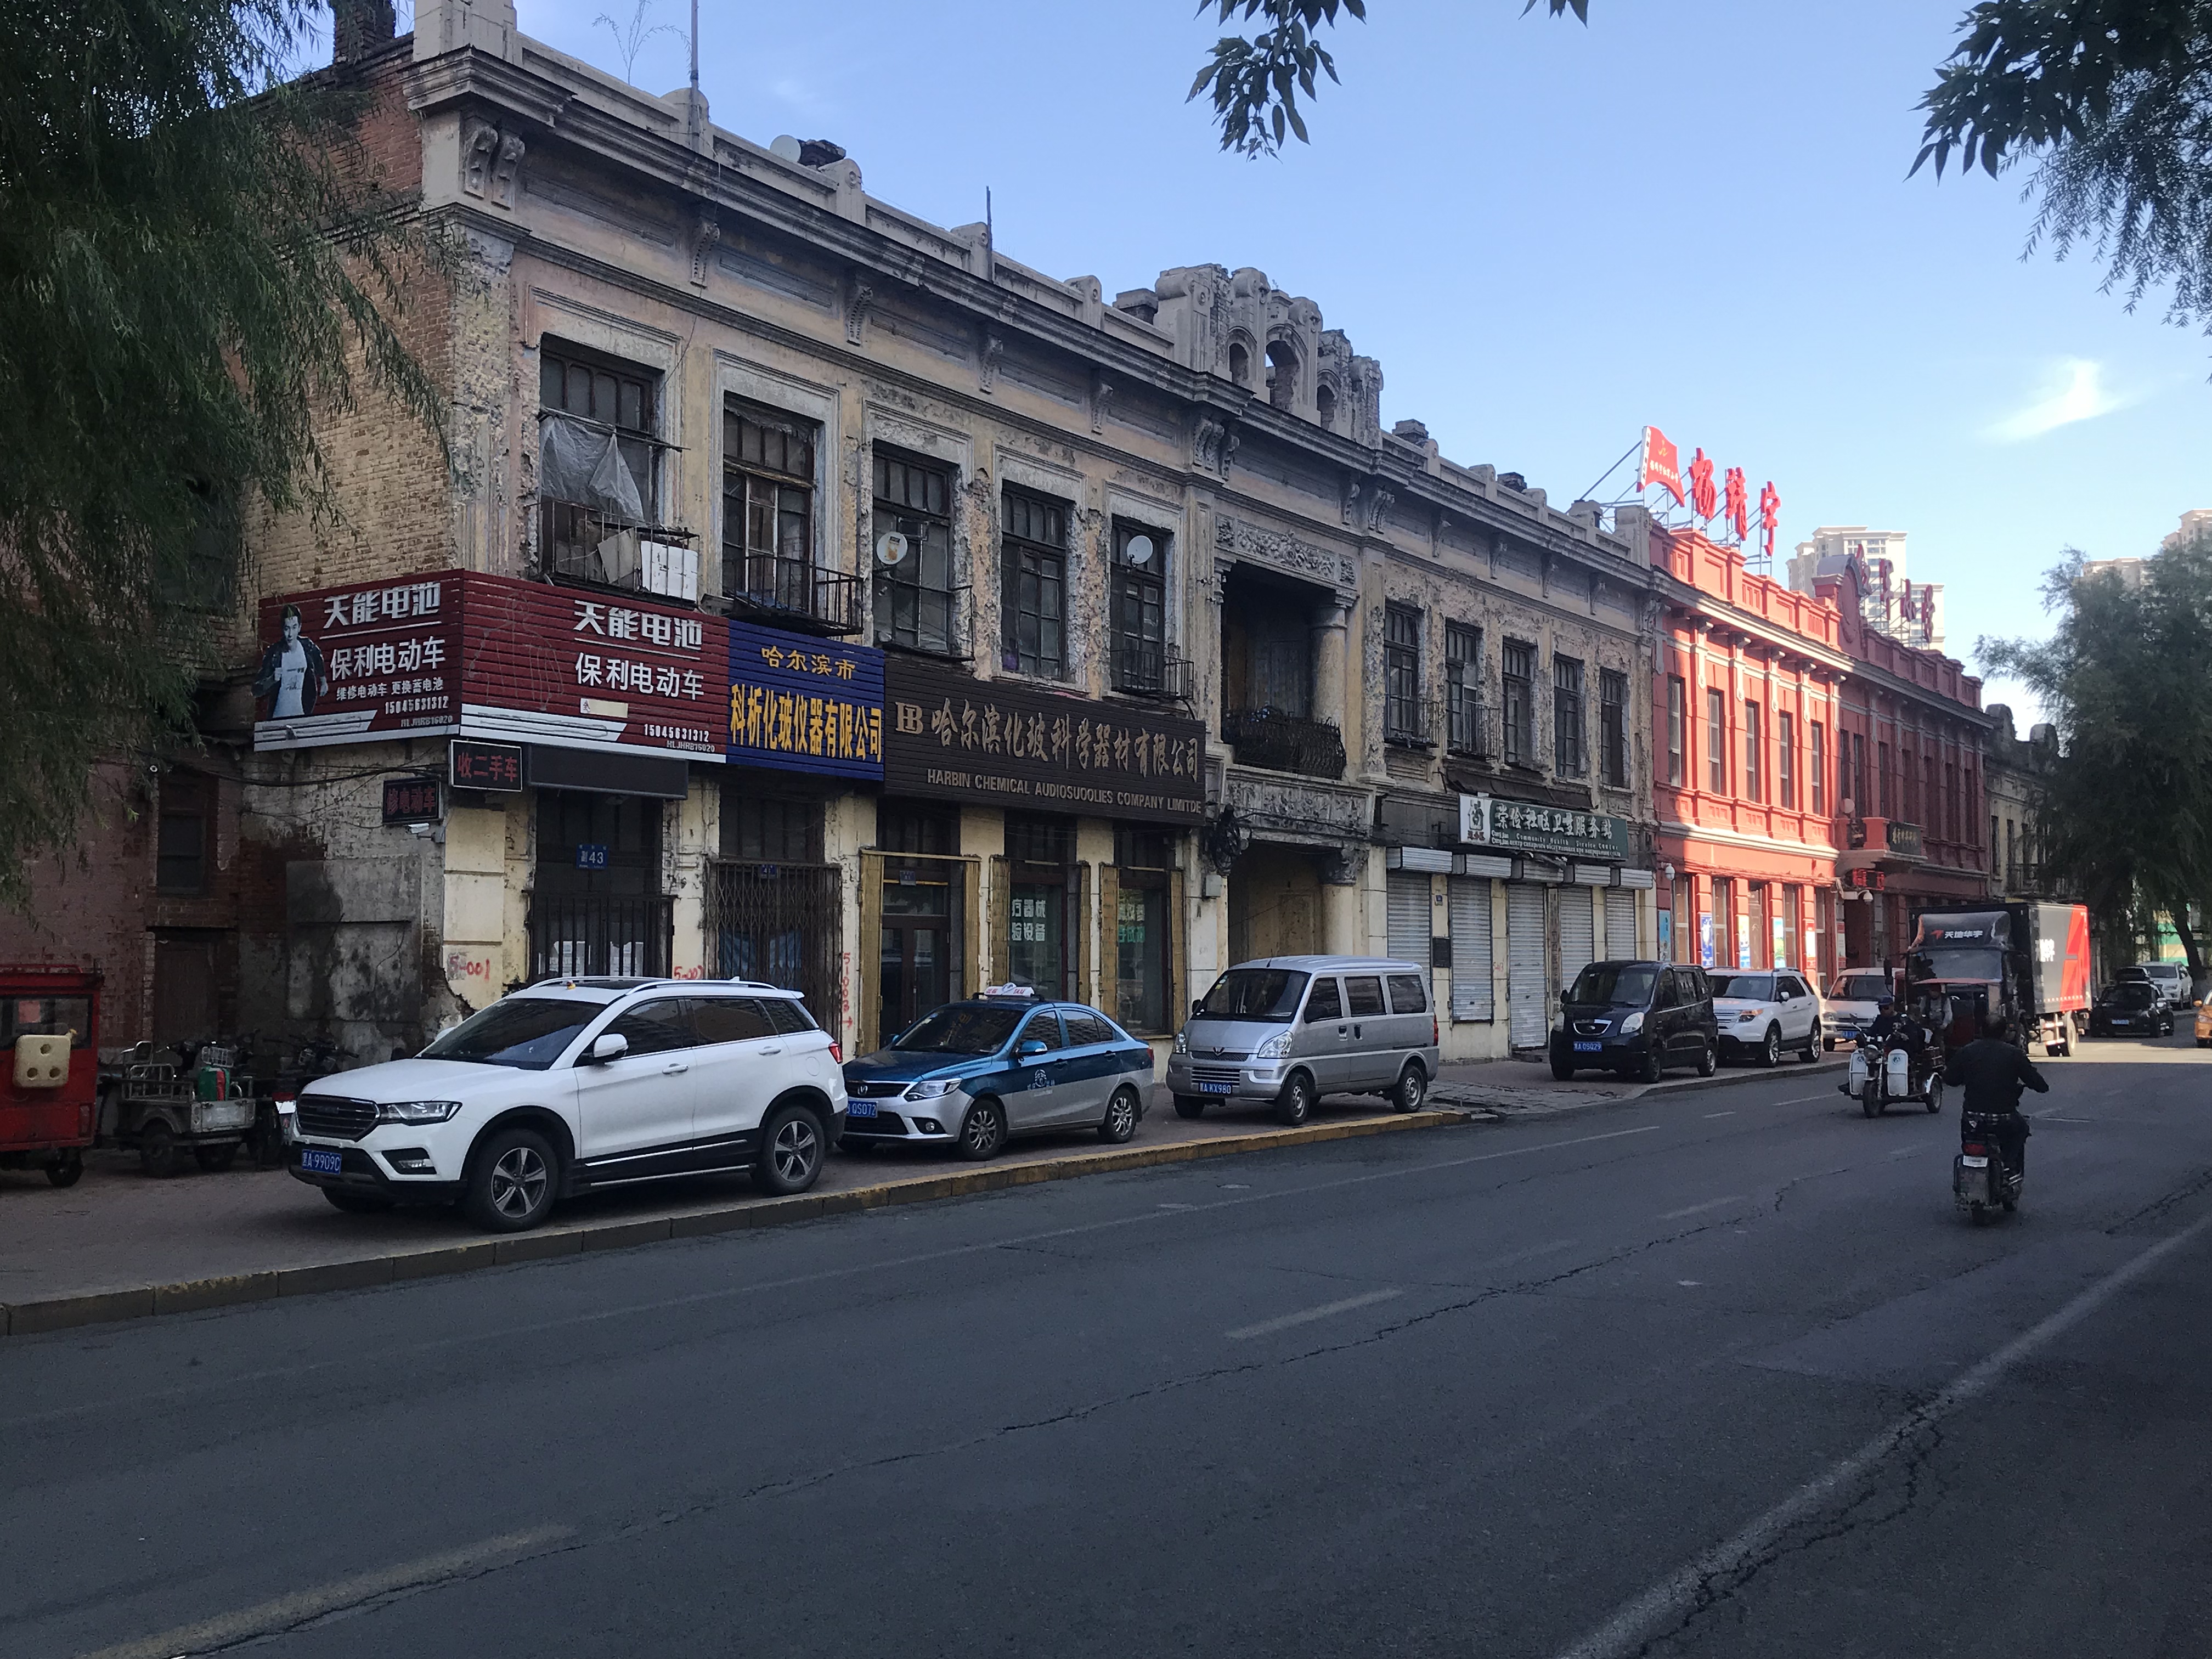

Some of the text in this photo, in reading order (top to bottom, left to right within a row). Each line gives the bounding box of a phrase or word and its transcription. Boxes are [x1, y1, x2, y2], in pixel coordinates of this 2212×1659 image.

[323, 582, 441, 629] 天能电池
[573, 600, 702, 650] 天能电池
[330, 636, 446, 681] 保利电动车
[575, 652, 704, 700] 保利电动车
[761, 645, 856, 680] 哈尔滨市
[336, 676, 444, 701] 维修电动车 更换蓄电池
[385, 696, 449, 714] 15045631312
[644, 724, 709, 742] 15045631312
[731, 684, 882, 763] 科析化玻仪器有限公司
[931, 698, 1197, 783] 哈尔滨化玻科学器材有限公司
[667, 740, 715, 752] HLJHRB16020
[457, 752, 518, 782] 收二手车
[386, 786, 436, 815] 修电动车
[927, 769, 970, 788] HARBIN
[975, 774, 1030, 794] CHEMICAL
[1117, 792, 1164, 809] COMPANY
[1167, 798, 1201, 814] LIMITDE
